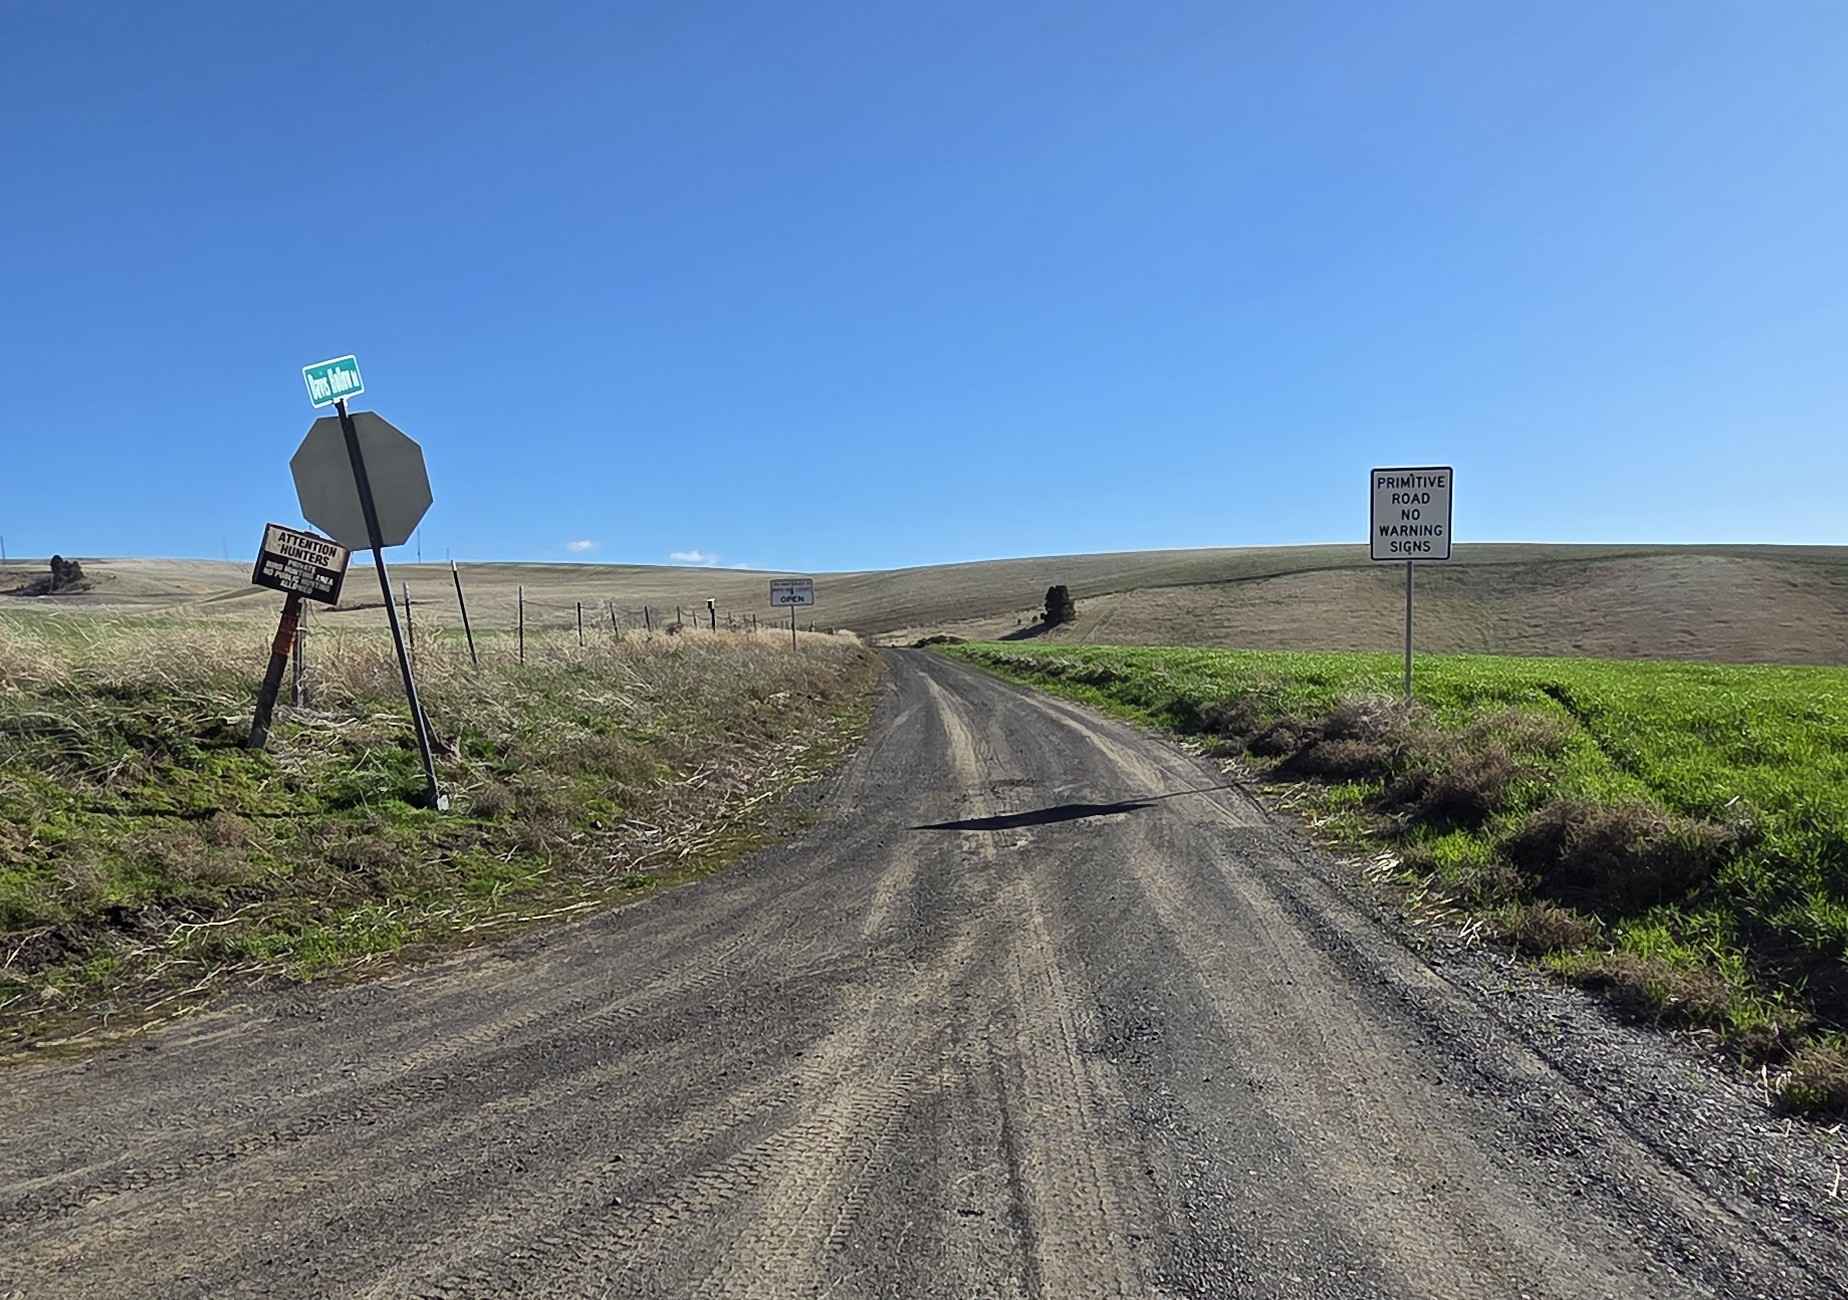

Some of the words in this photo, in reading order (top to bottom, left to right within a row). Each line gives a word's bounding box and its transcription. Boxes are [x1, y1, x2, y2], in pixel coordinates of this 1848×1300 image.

[1377, 476, 1445, 489] PRIMITIVE
[1391, 492, 1431, 505] ROAD
[1401, 508, 1421, 521] NO
[1379, 525, 1443, 537] WARNING
[278, 532, 338, 558] ATTENTION
[1390, 540, 1431, 553] SIGNS
[280, 543, 330, 567] HUNTERS
